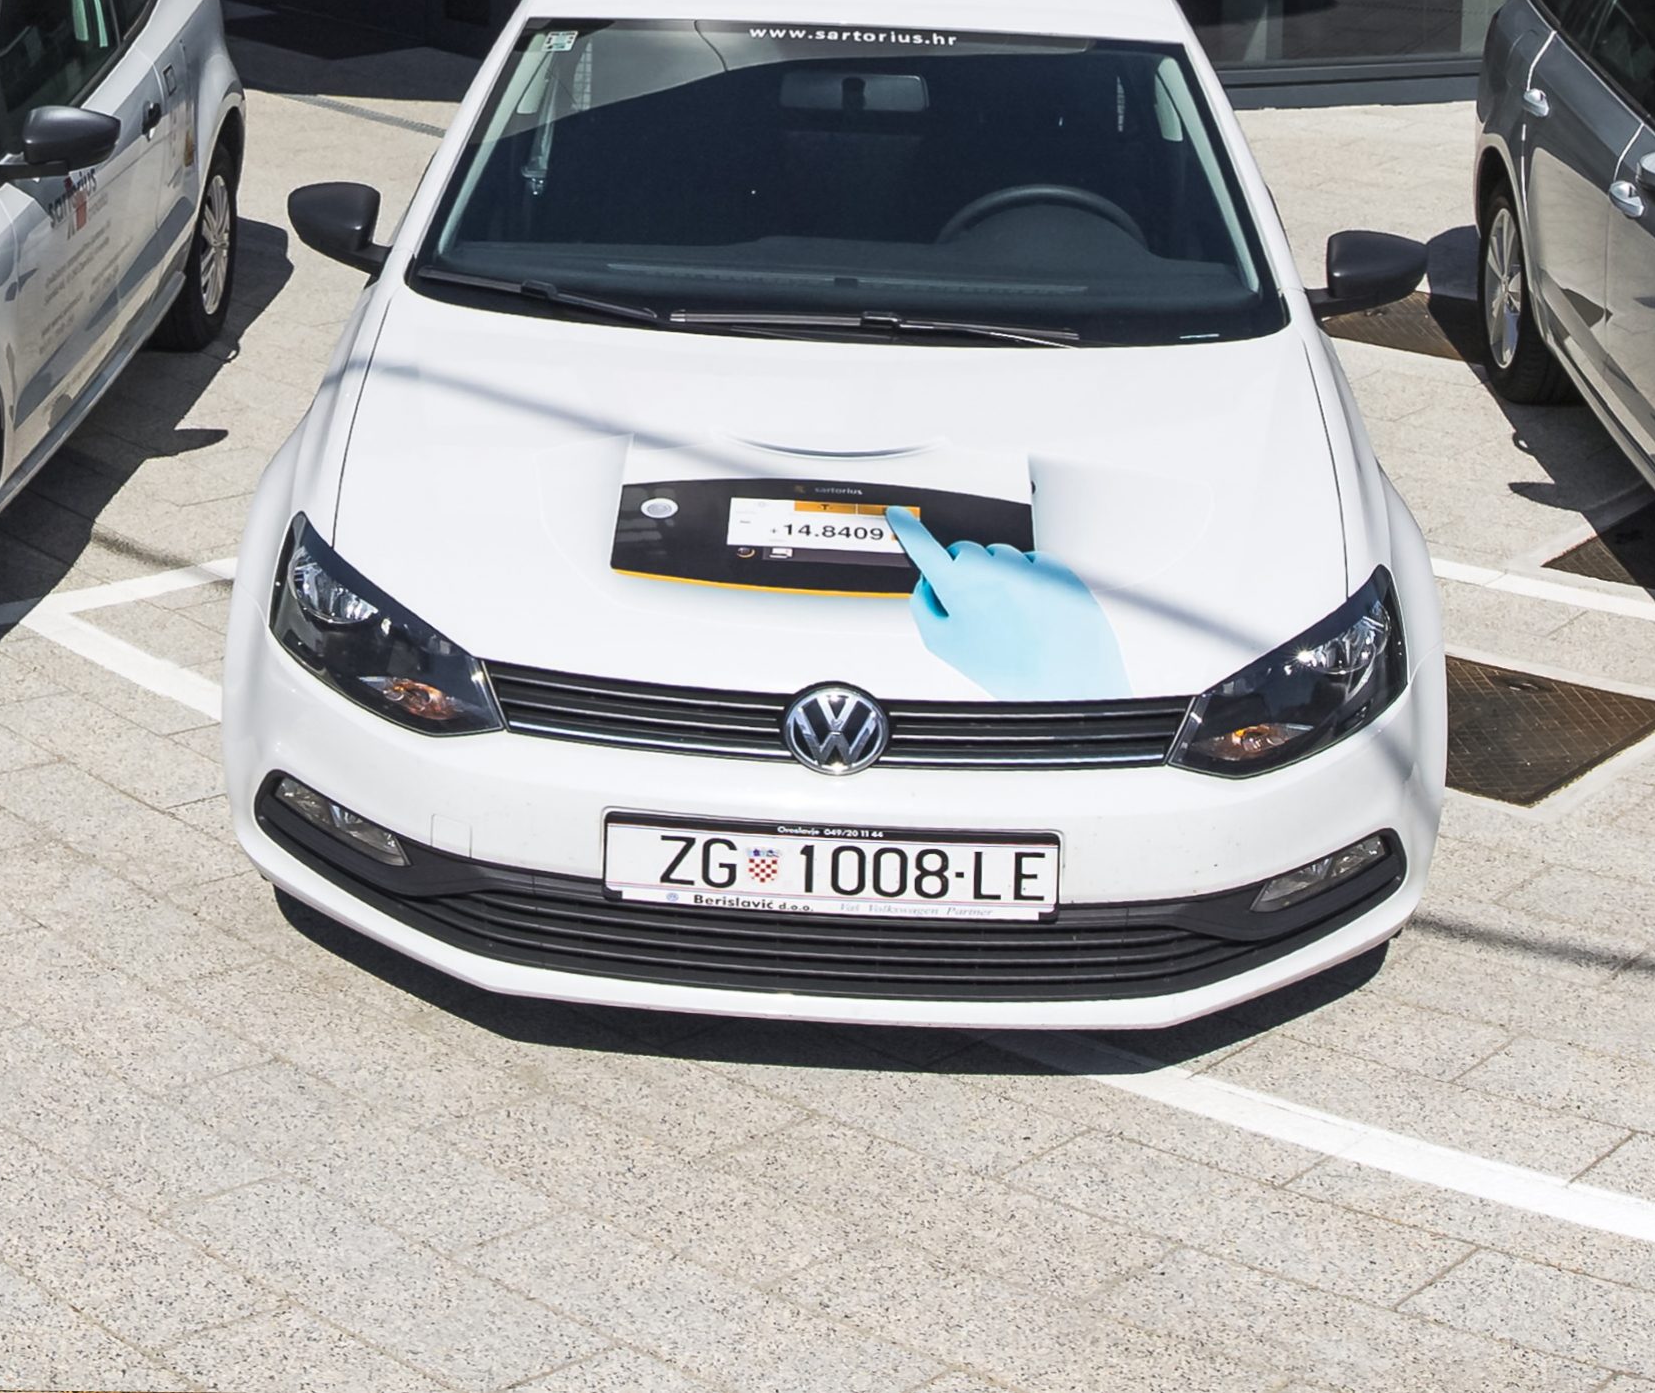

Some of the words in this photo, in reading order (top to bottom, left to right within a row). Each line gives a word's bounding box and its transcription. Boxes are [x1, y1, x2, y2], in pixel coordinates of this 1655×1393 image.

[749, 27, 957, 46] www.sartorius.hr
[815, 486, 863, 495] sartorius
[659, 835, 738, 888] ZG
[693, 894, 774, 911] Berislavić
[778, 902, 814, 913] d.o.o.
[946, 906, 996, 917] Partner
